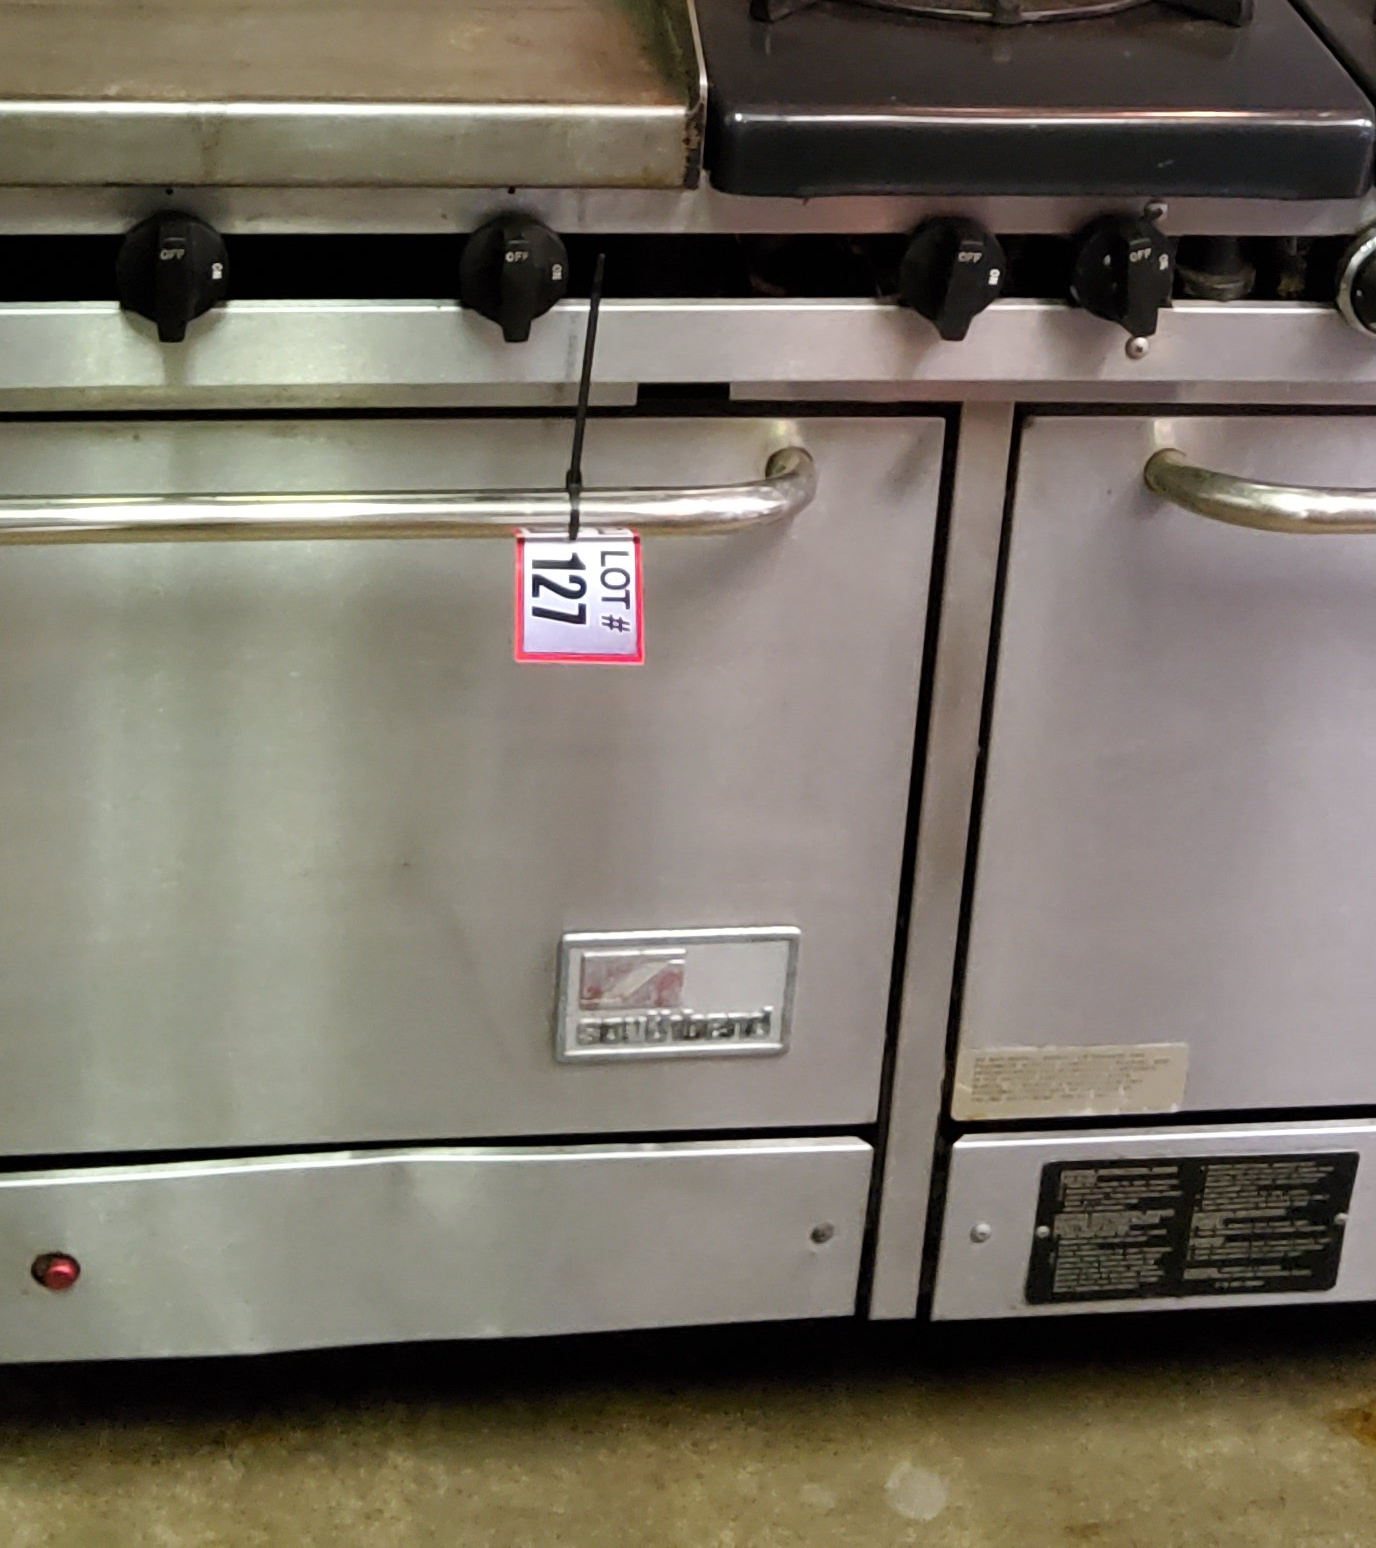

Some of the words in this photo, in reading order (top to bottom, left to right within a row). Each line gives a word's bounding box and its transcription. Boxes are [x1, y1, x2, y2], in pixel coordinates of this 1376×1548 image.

[505, 251, 529, 263] OFF
[1129, 248, 1152, 263] OFF
[532, 552, 587, 625] 127
[600, 551, 631, 610] LOT
[601, 614, 631, 633] #
